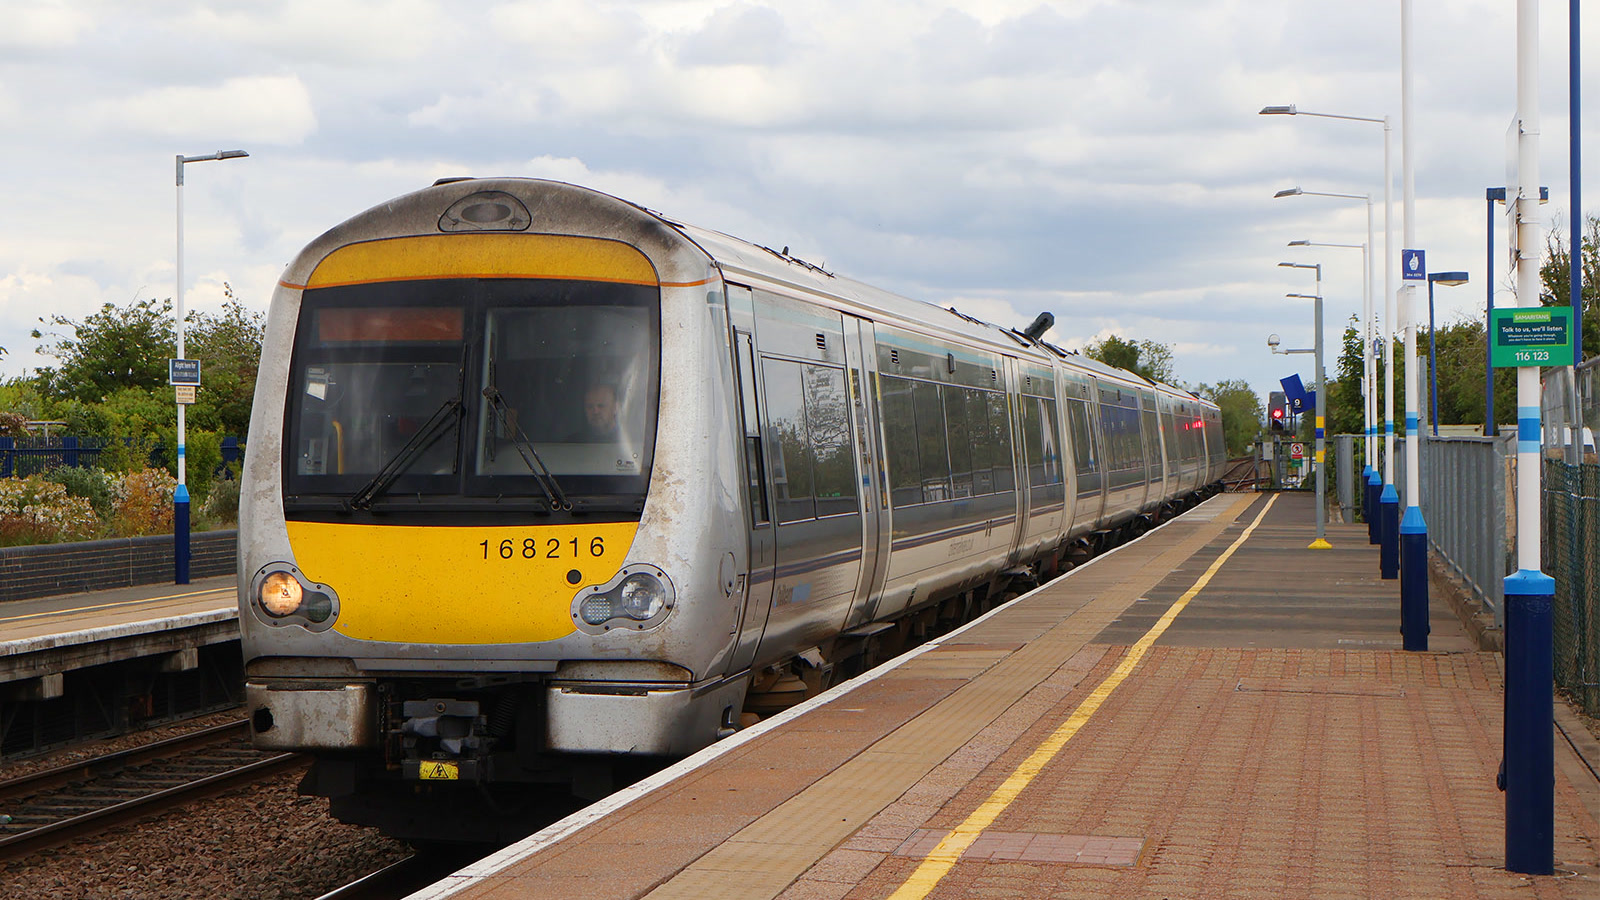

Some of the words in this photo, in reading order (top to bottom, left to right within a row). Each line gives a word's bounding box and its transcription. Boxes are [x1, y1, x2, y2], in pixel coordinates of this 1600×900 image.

[1515, 352, 1531, 361] 116
[1532, 351, 1550, 361] 123
[1294, 398, 1301, 406] 9
[479, 536, 605, 560] 168216
